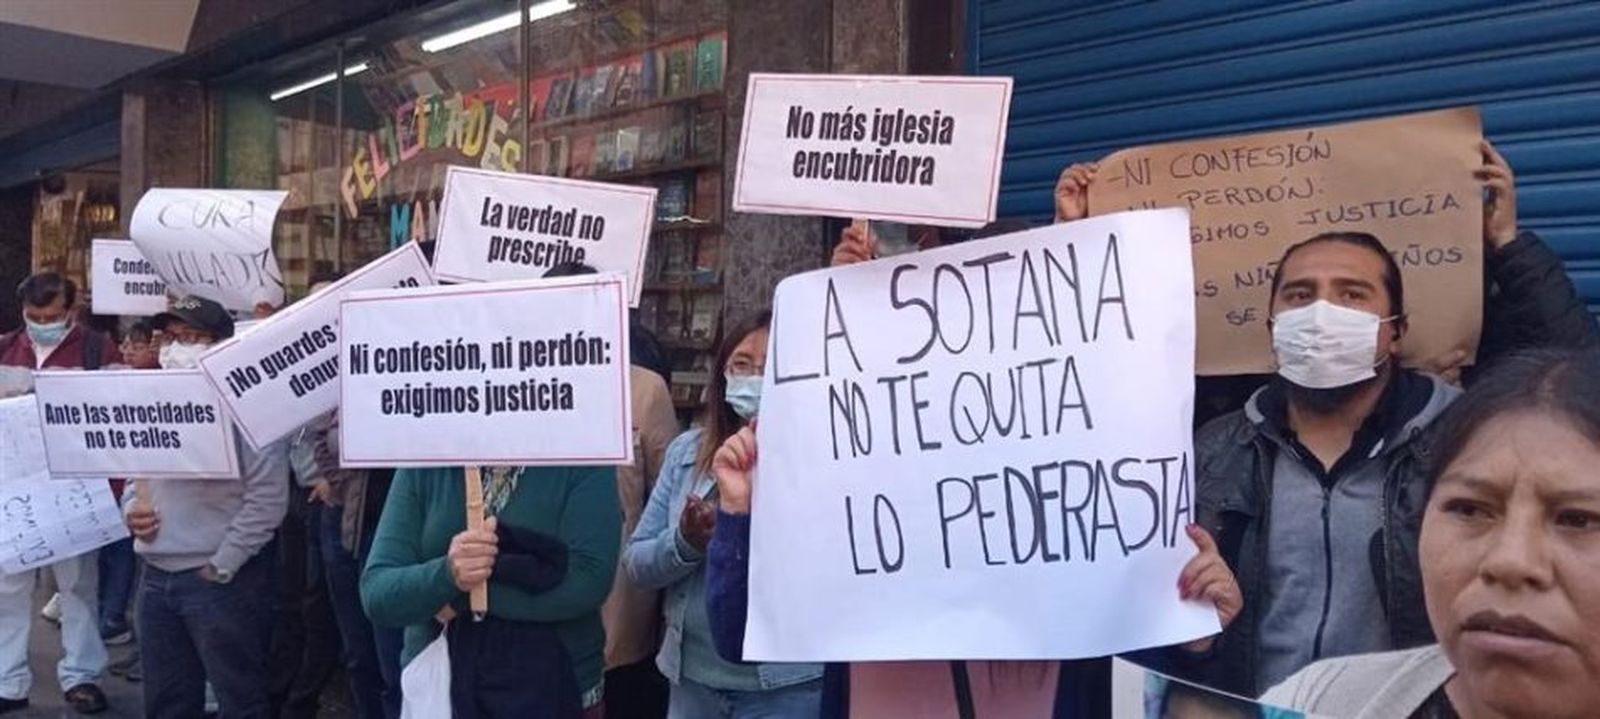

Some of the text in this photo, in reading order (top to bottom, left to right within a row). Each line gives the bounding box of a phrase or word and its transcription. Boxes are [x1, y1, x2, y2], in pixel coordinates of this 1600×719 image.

[787, 105, 955, 147] No más iglesia
[793, 148, 936, 186] encubridora
[1170, 132, 1332, 179] CONFESIÓN
[480, 197, 605, 241] La verdad no
[1298, 193, 1461, 225] JUSTICIA
[488, 233, 586, 268] prescribe
[1391, 243, 1463, 267] ÑOS
[773, 232, 1135, 385] LA SOTANA
[225, 324, 337, 398] ¡No guardes
[349, 330, 611, 376] Ni confesión, ni perdón:
[44, 401, 216, 426] Ante las atrocidades
[381, 379, 574, 418] exigimos justicia
[828, 355, 1093, 461] NO TE QUITA
[84, 427, 182, 450] no te calles
[846, 452, 1195, 576] LO PEDERASTA
